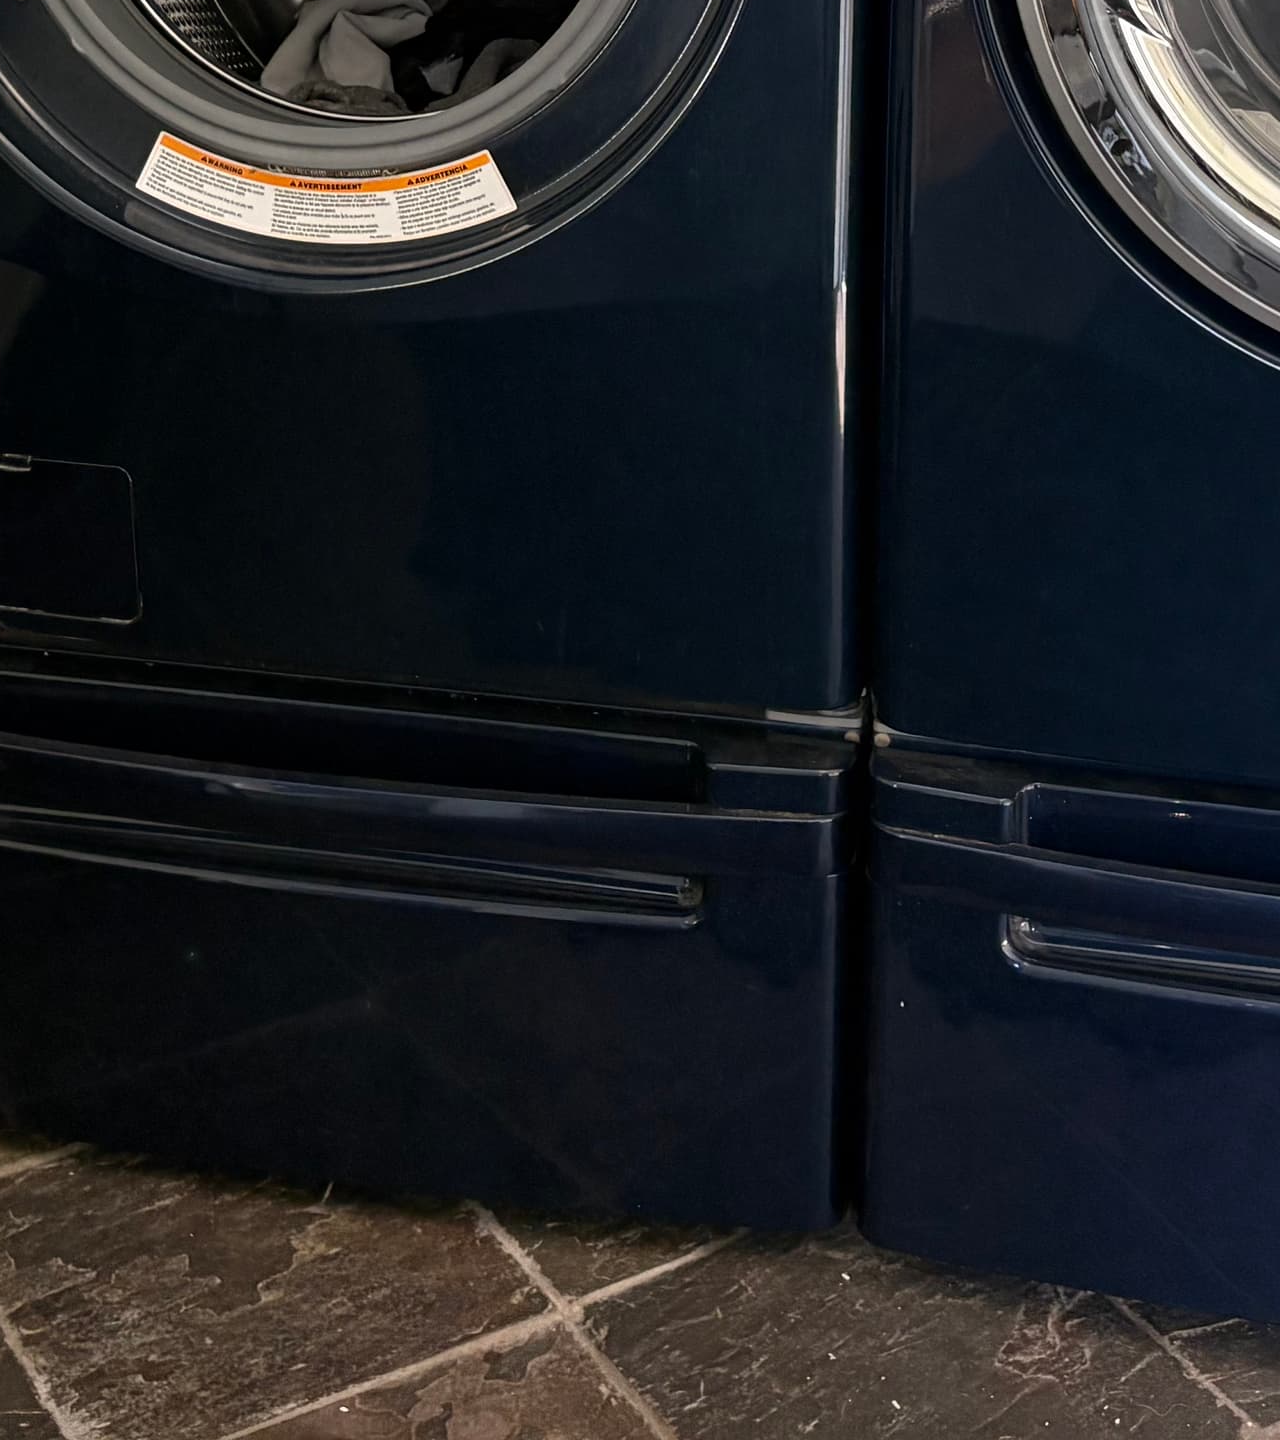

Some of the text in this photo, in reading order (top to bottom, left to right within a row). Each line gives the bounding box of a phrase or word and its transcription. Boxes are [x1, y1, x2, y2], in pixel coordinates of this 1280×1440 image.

[208, 158, 244, 176] WARNING
[415, 164, 468, 184] ADVERTENCIA
[297, 181, 362, 191] AVERTISSEMENT
